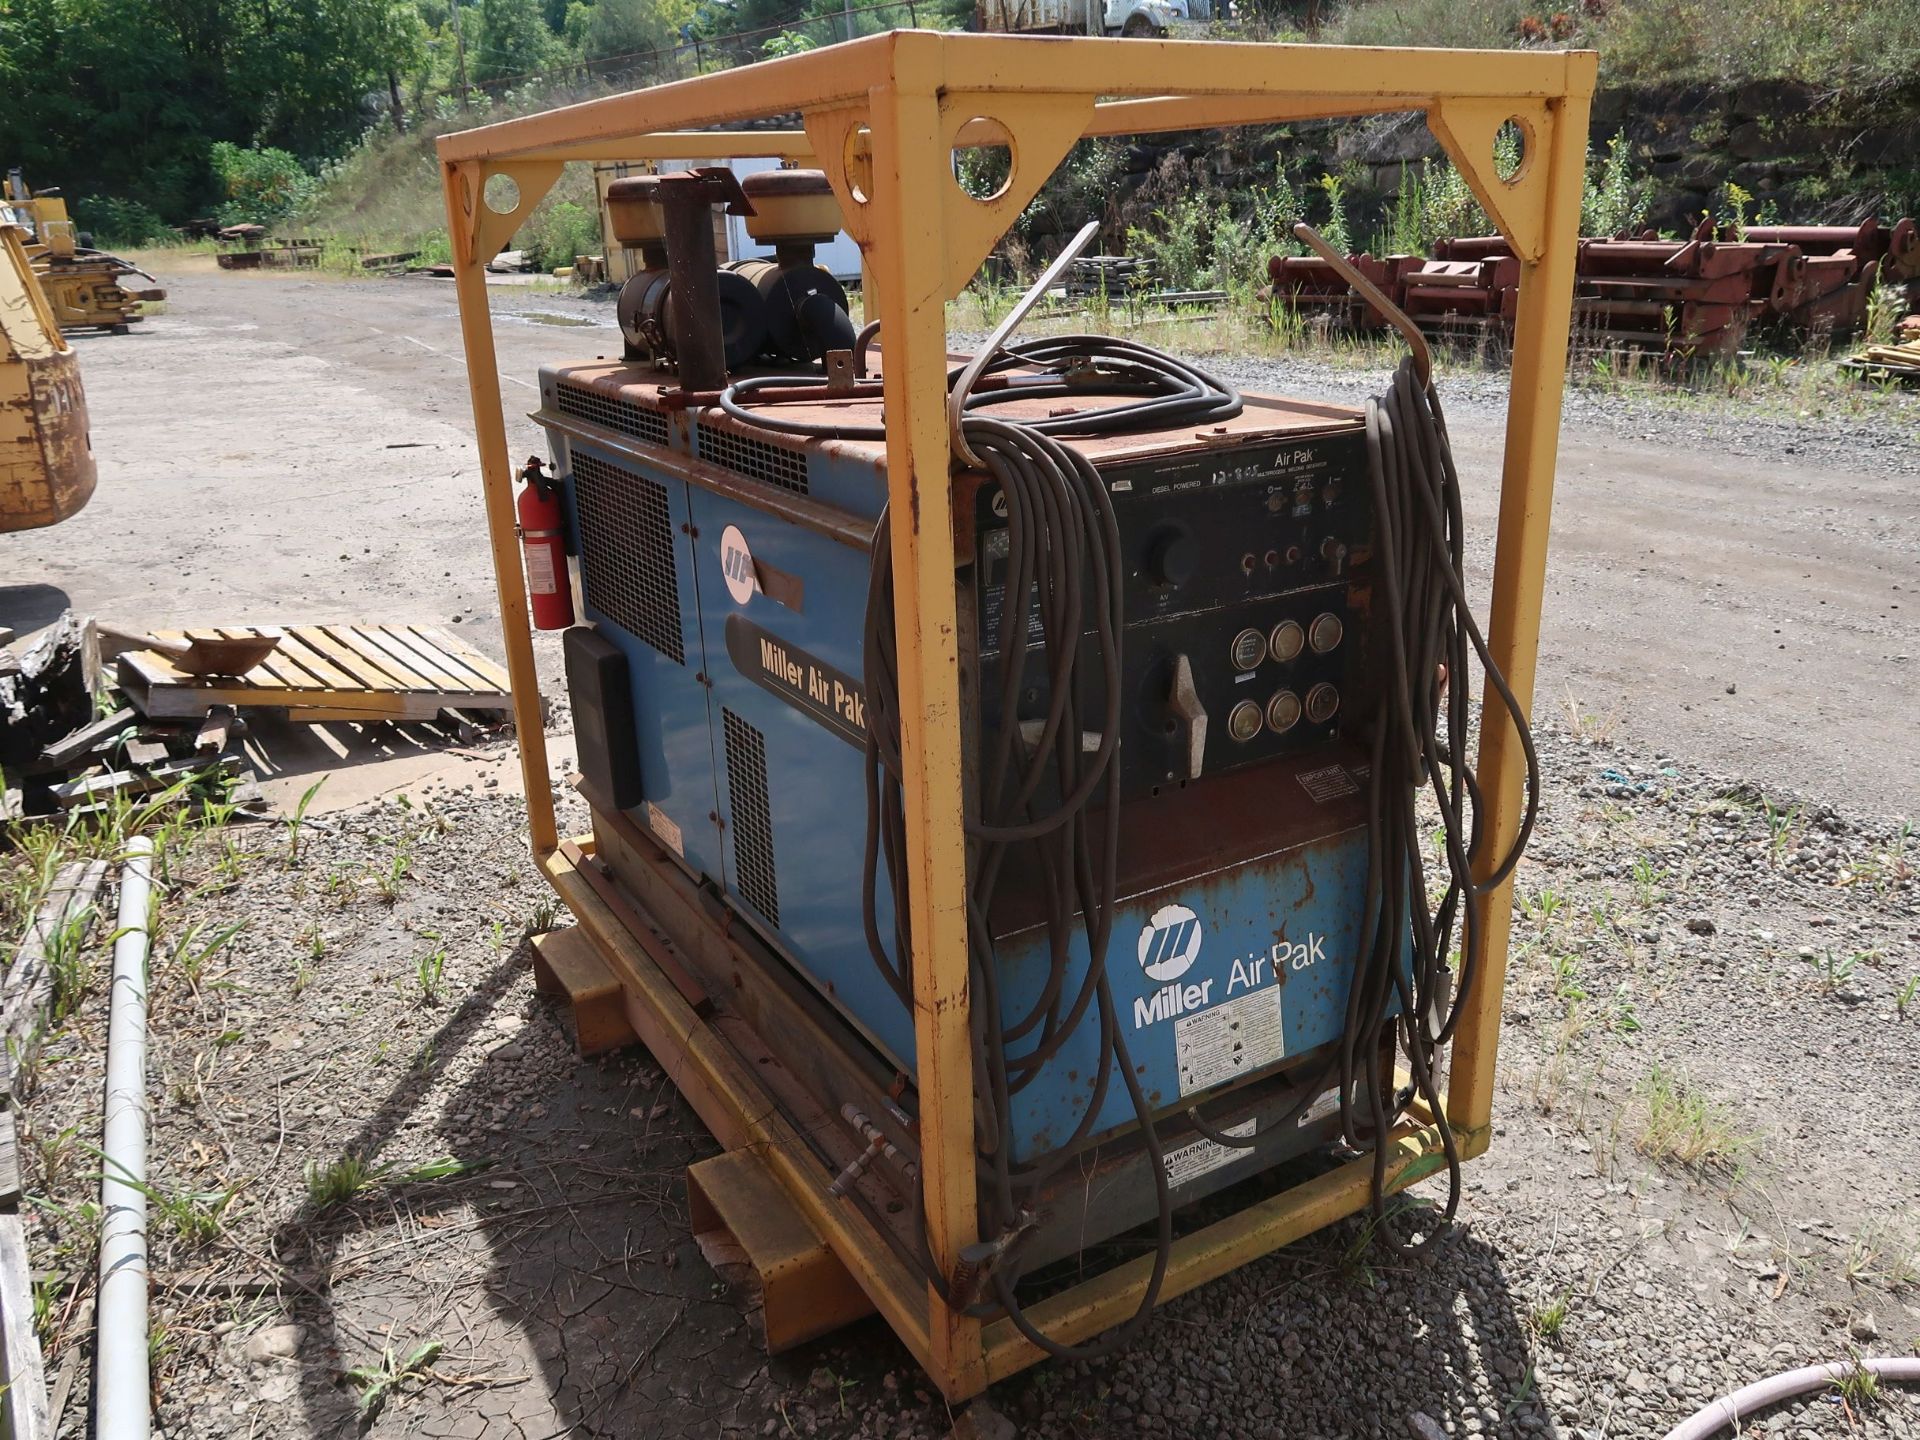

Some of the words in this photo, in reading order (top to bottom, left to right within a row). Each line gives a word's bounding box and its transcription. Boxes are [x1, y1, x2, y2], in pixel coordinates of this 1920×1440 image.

[1274, 452, 1291, 468] Air
[1293, 448, 1313, 465] Pak
[1173, 480, 1201, 491] POWERED
[760, 637, 803, 690] Miller
[808, 665, 829, 706] Air
[834, 679, 866, 730] Pak
[1134, 978, 1213, 1030] Miller
[1226, 953, 1266, 995] Air
[1271, 932, 1326, 978] Pak
[1191, 1009, 1221, 1025] WARNING
